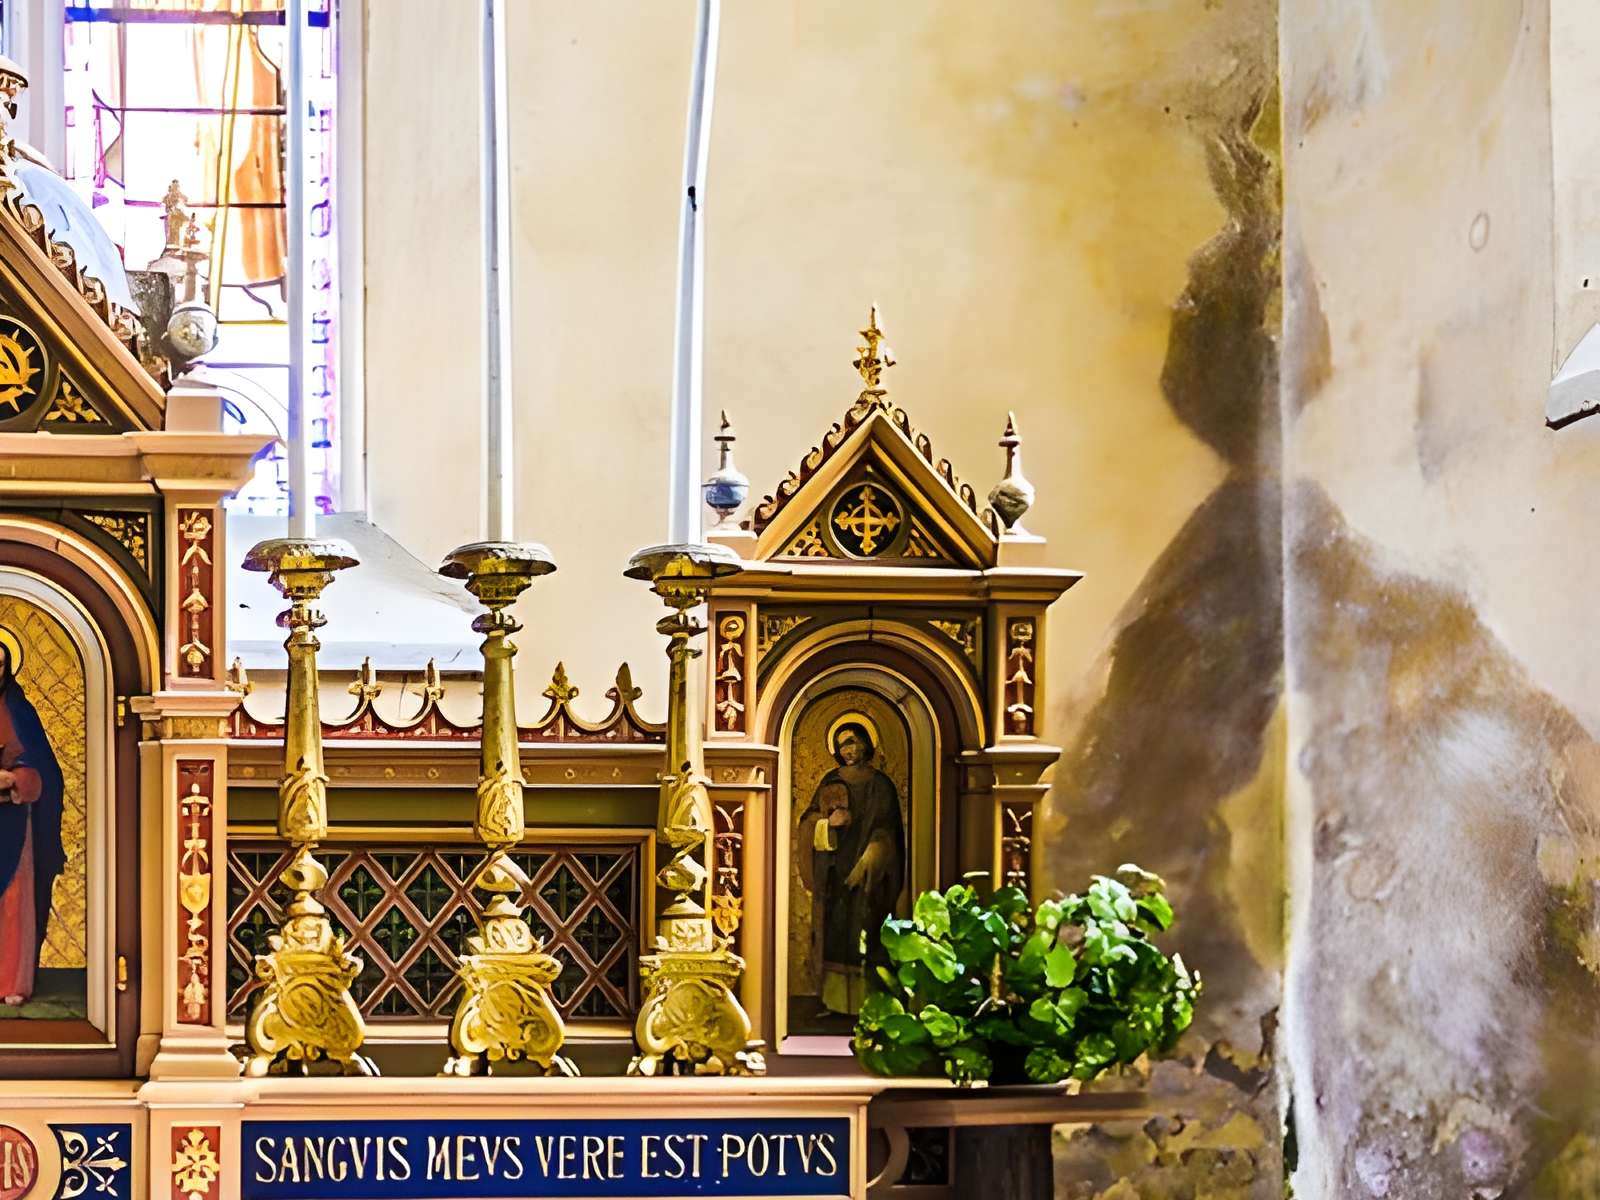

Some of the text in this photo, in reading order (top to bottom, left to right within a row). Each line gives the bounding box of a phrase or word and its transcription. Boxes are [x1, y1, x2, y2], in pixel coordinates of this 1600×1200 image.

[255, 1133, 837, 1183] SANGVIS MEVS VERE EST POTVS
